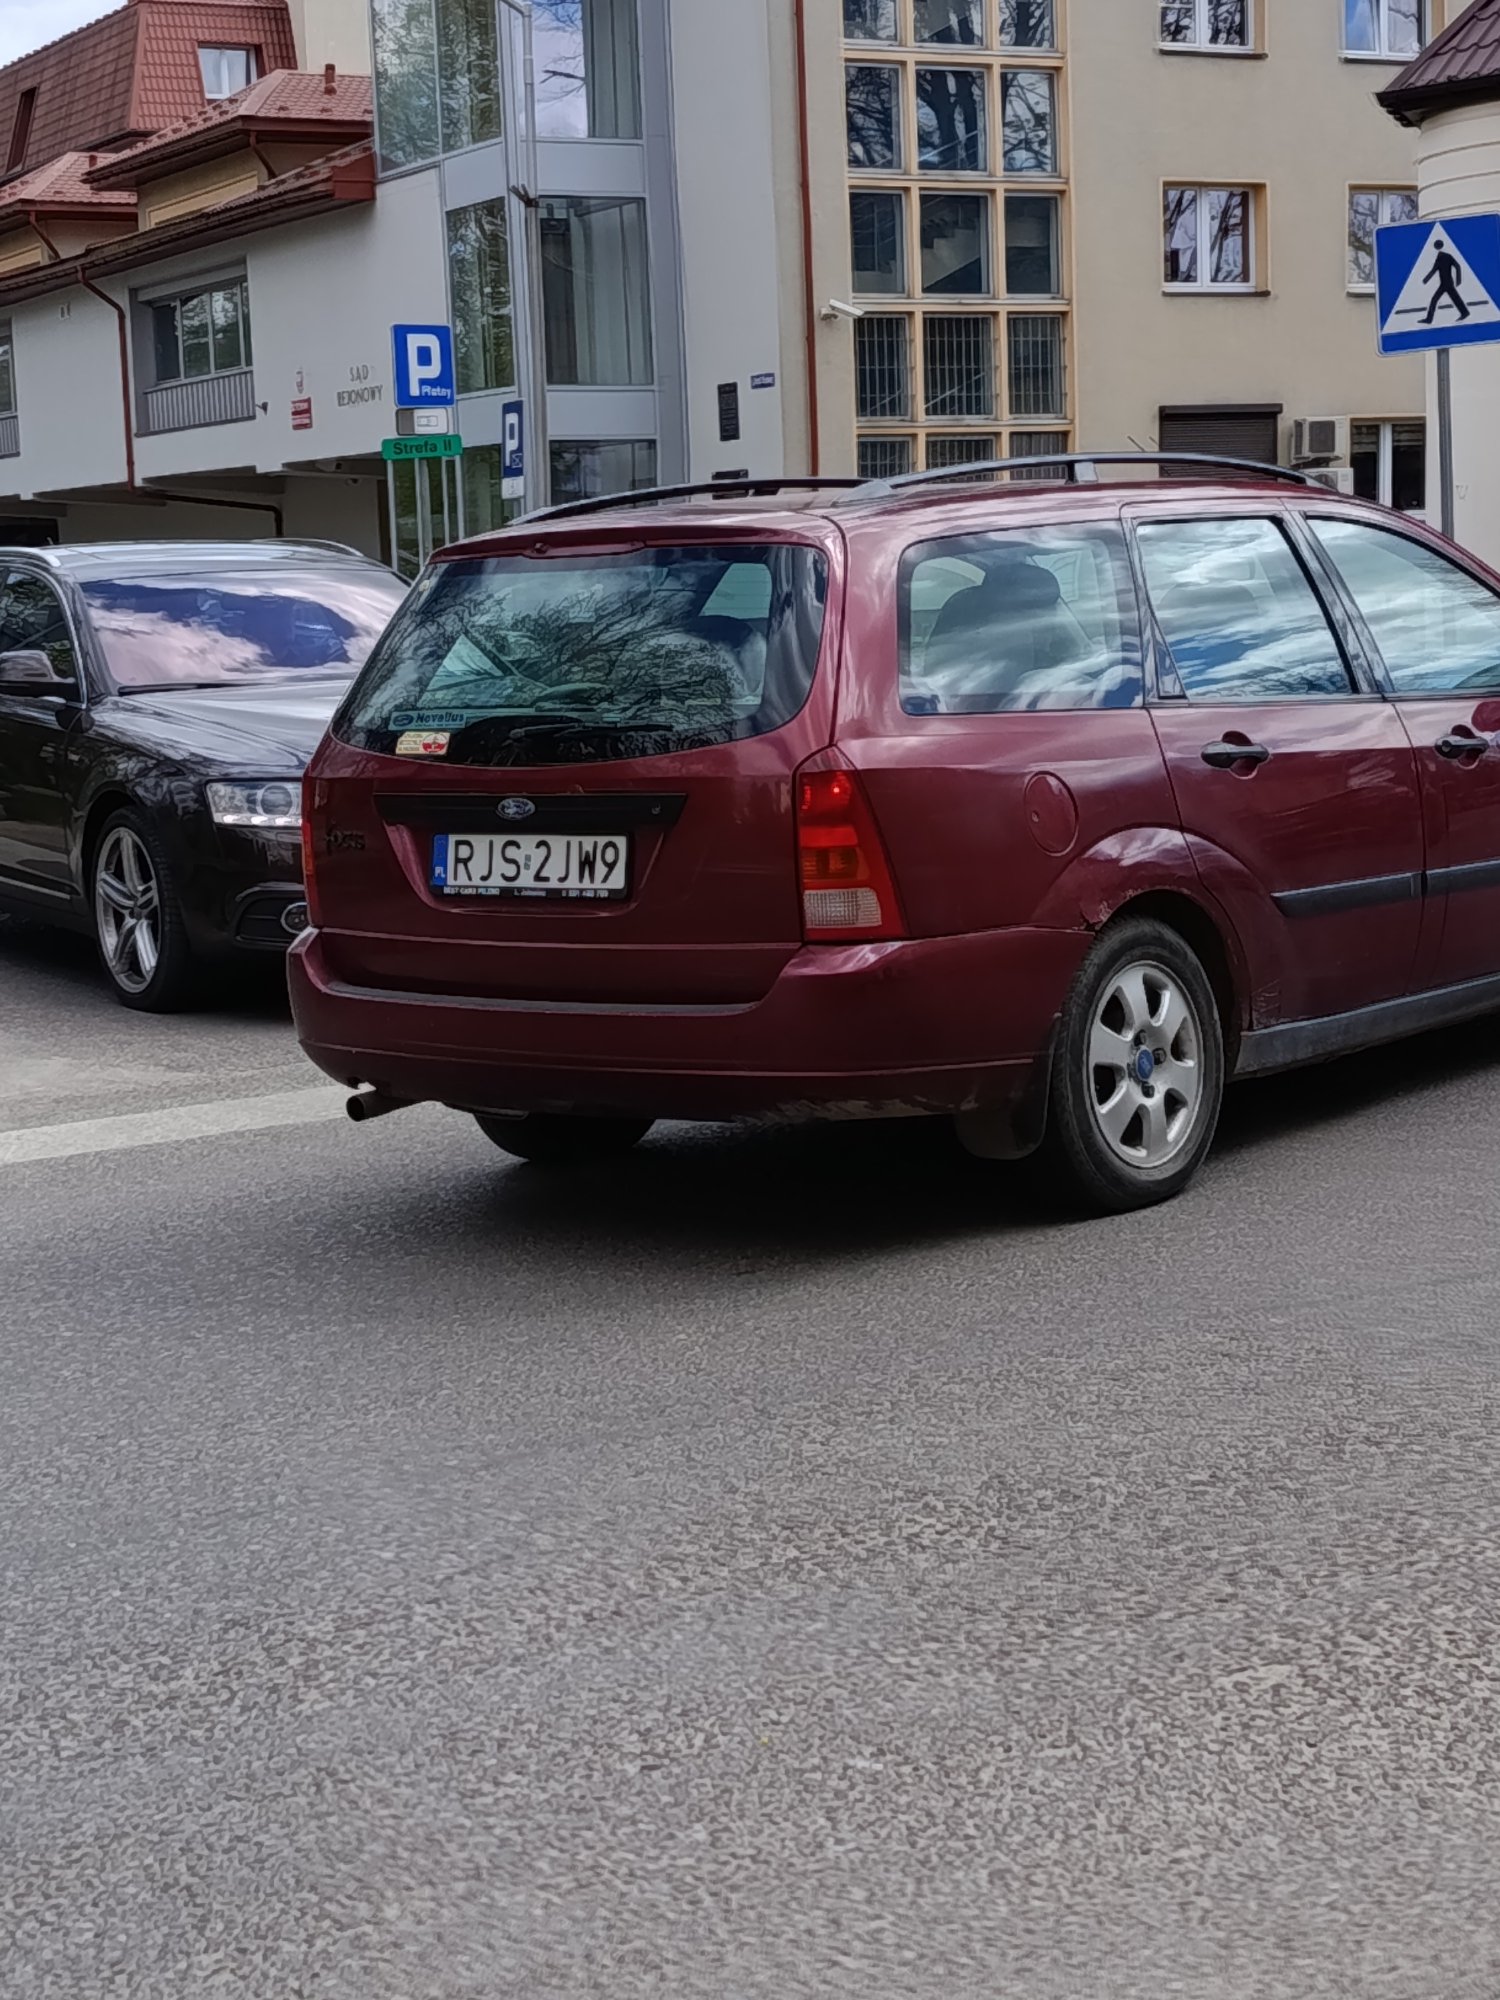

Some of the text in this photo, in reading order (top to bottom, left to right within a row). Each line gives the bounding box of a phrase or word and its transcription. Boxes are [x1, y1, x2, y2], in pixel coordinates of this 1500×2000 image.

[406, 333, 442, 397] P
[393, 439, 452, 456] Strefa II
[505, 412, 519, 467] P
[434, 866, 446, 878] PL
[453, 839, 620, 884] RJS 2JW9
